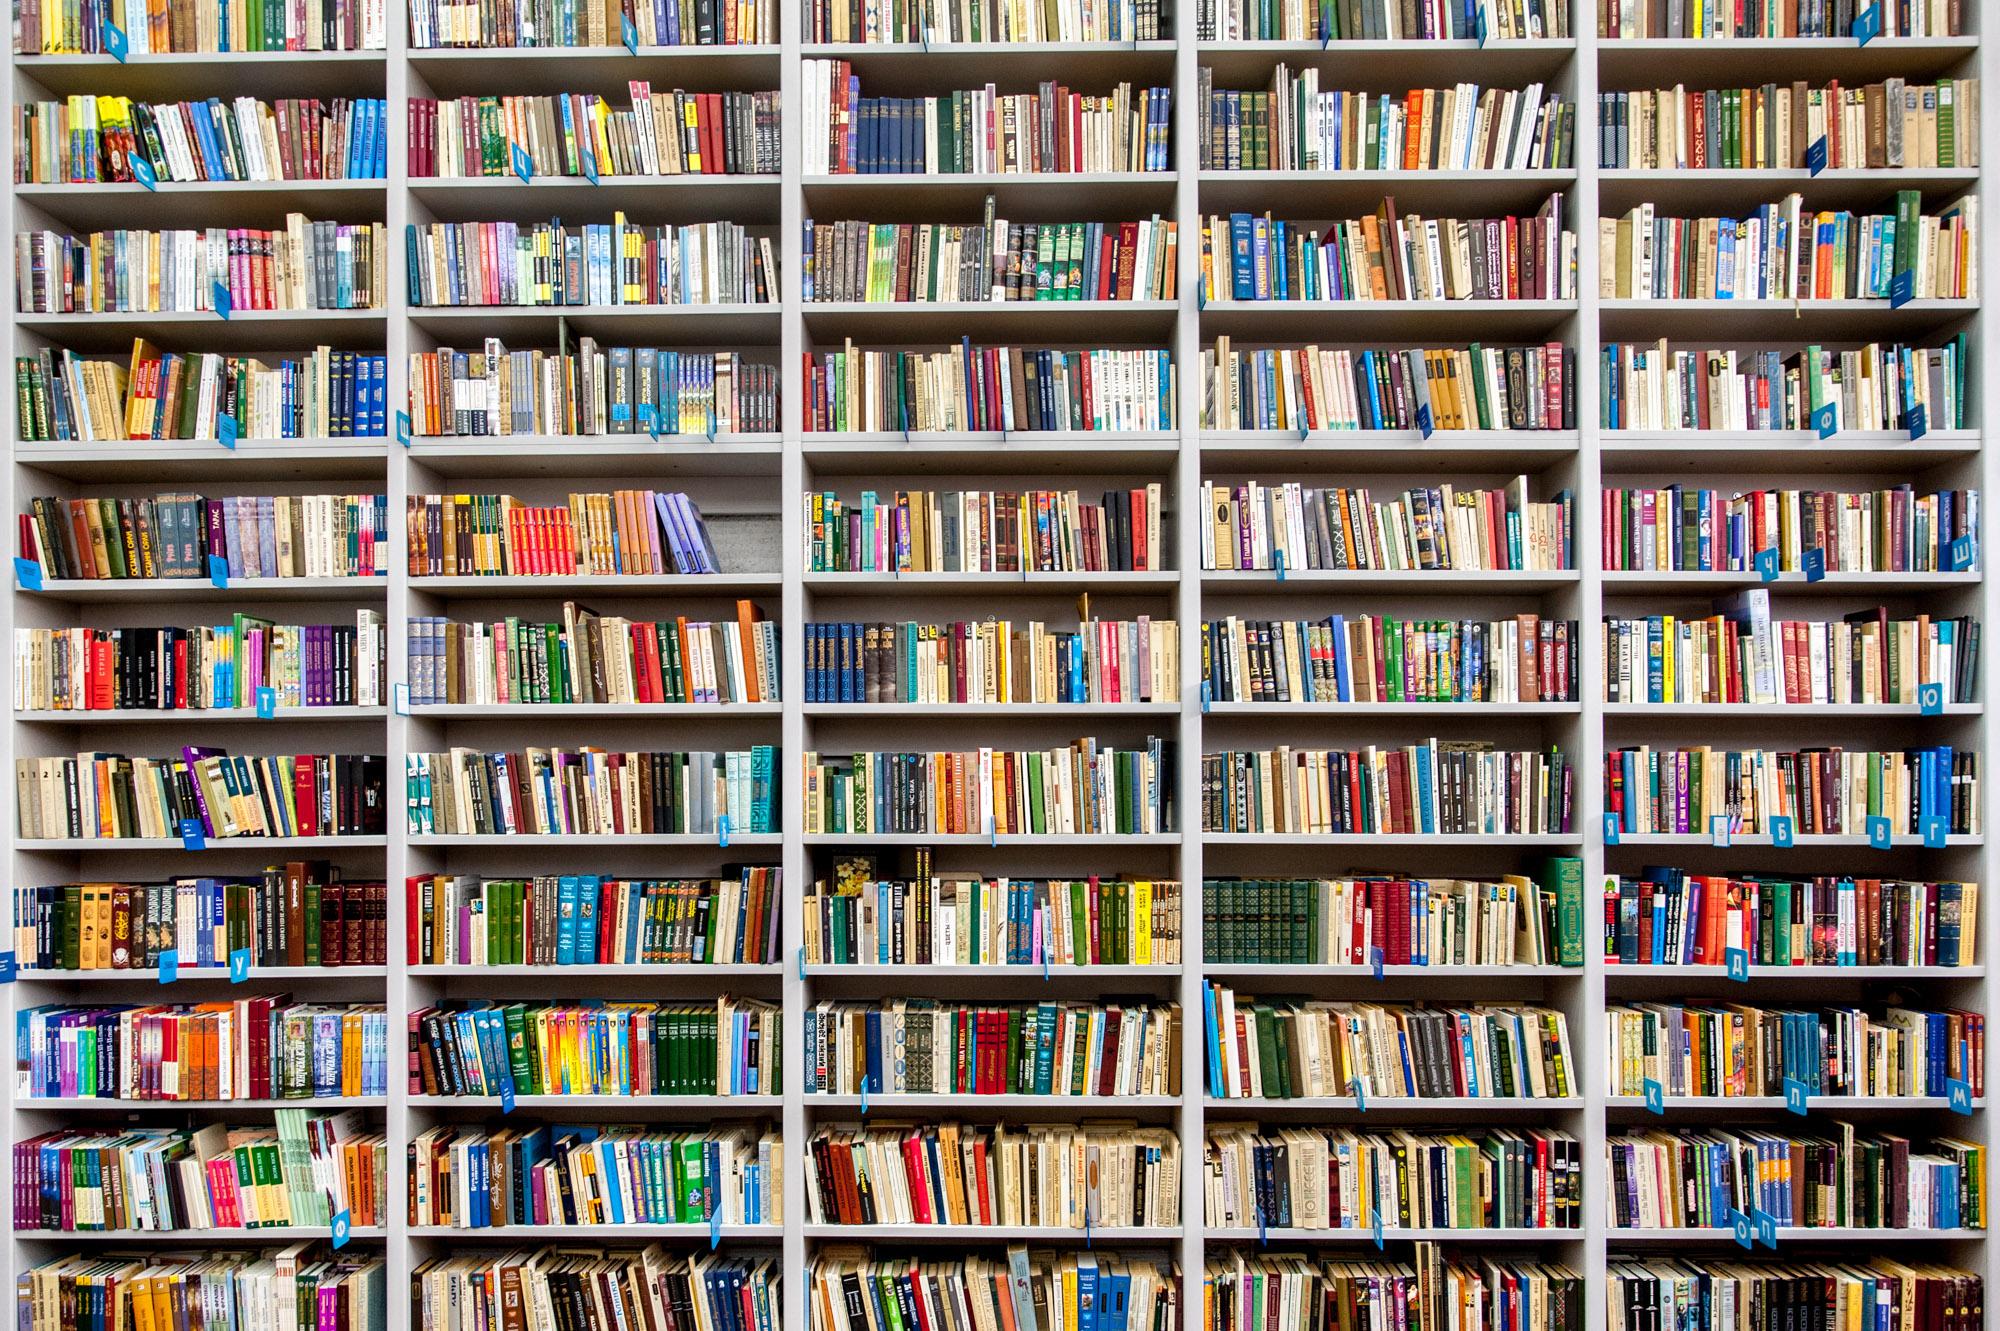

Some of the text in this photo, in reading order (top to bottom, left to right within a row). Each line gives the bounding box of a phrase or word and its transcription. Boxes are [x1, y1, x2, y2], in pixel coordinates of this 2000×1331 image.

[1864, 13, 1872, 34] Т
[126, 531, 134, 549] ОРЛИ
[141, 532, 150, 550] ОРЛИ
[1764, 556, 1774, 574] Ч
[262, 694, 270, 712] Т
[1922, 688, 1938, 708] Ю
[1607, 818, 1614, 836] Я
[1778, 823, 1787, 841] Б
[1876, 824, 1886, 842] В
[1930, 824, 1938, 841] Г
[234, 956, 244, 976] У
[1732, 954, 1743, 976] Д
[1649, 1087, 1657, 1106] К
[1953, 1087, 1966, 1107] М
[102, 1166, 112, 1195] УКРАЇНКА
[113, 1165, 122, 1195] УКРАЇНКА
[1737, 1220, 1747, 1240] О
[1762, 1220, 1770, 1240] П
